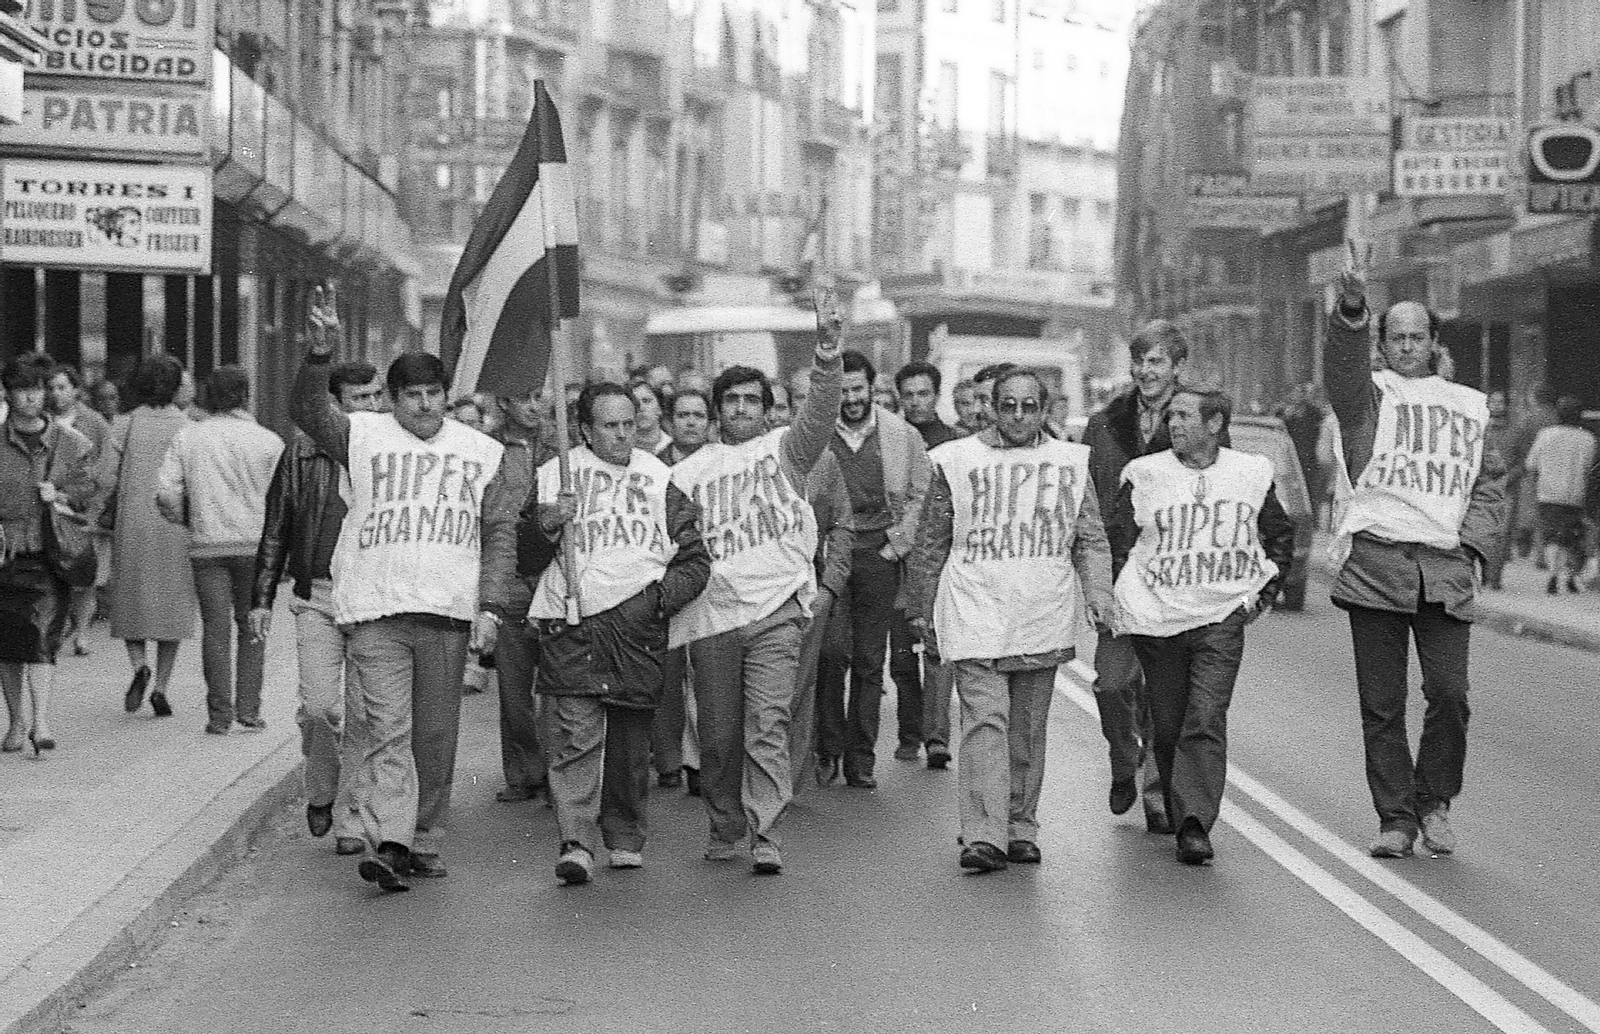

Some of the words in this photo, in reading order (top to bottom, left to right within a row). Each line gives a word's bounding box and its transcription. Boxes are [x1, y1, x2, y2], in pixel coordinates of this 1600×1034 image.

[43, 97, 200, 137] PATRIA
[14, 179, 168, 198] TORRES
[371, 452, 482, 506] HIPER
[967, 462, 1078, 525] HIPER
[358, 505, 479, 550] GRANADA
[1154, 499, 1254, 555] HIPER
[1143, 550, 1266, 588] GRANADA
